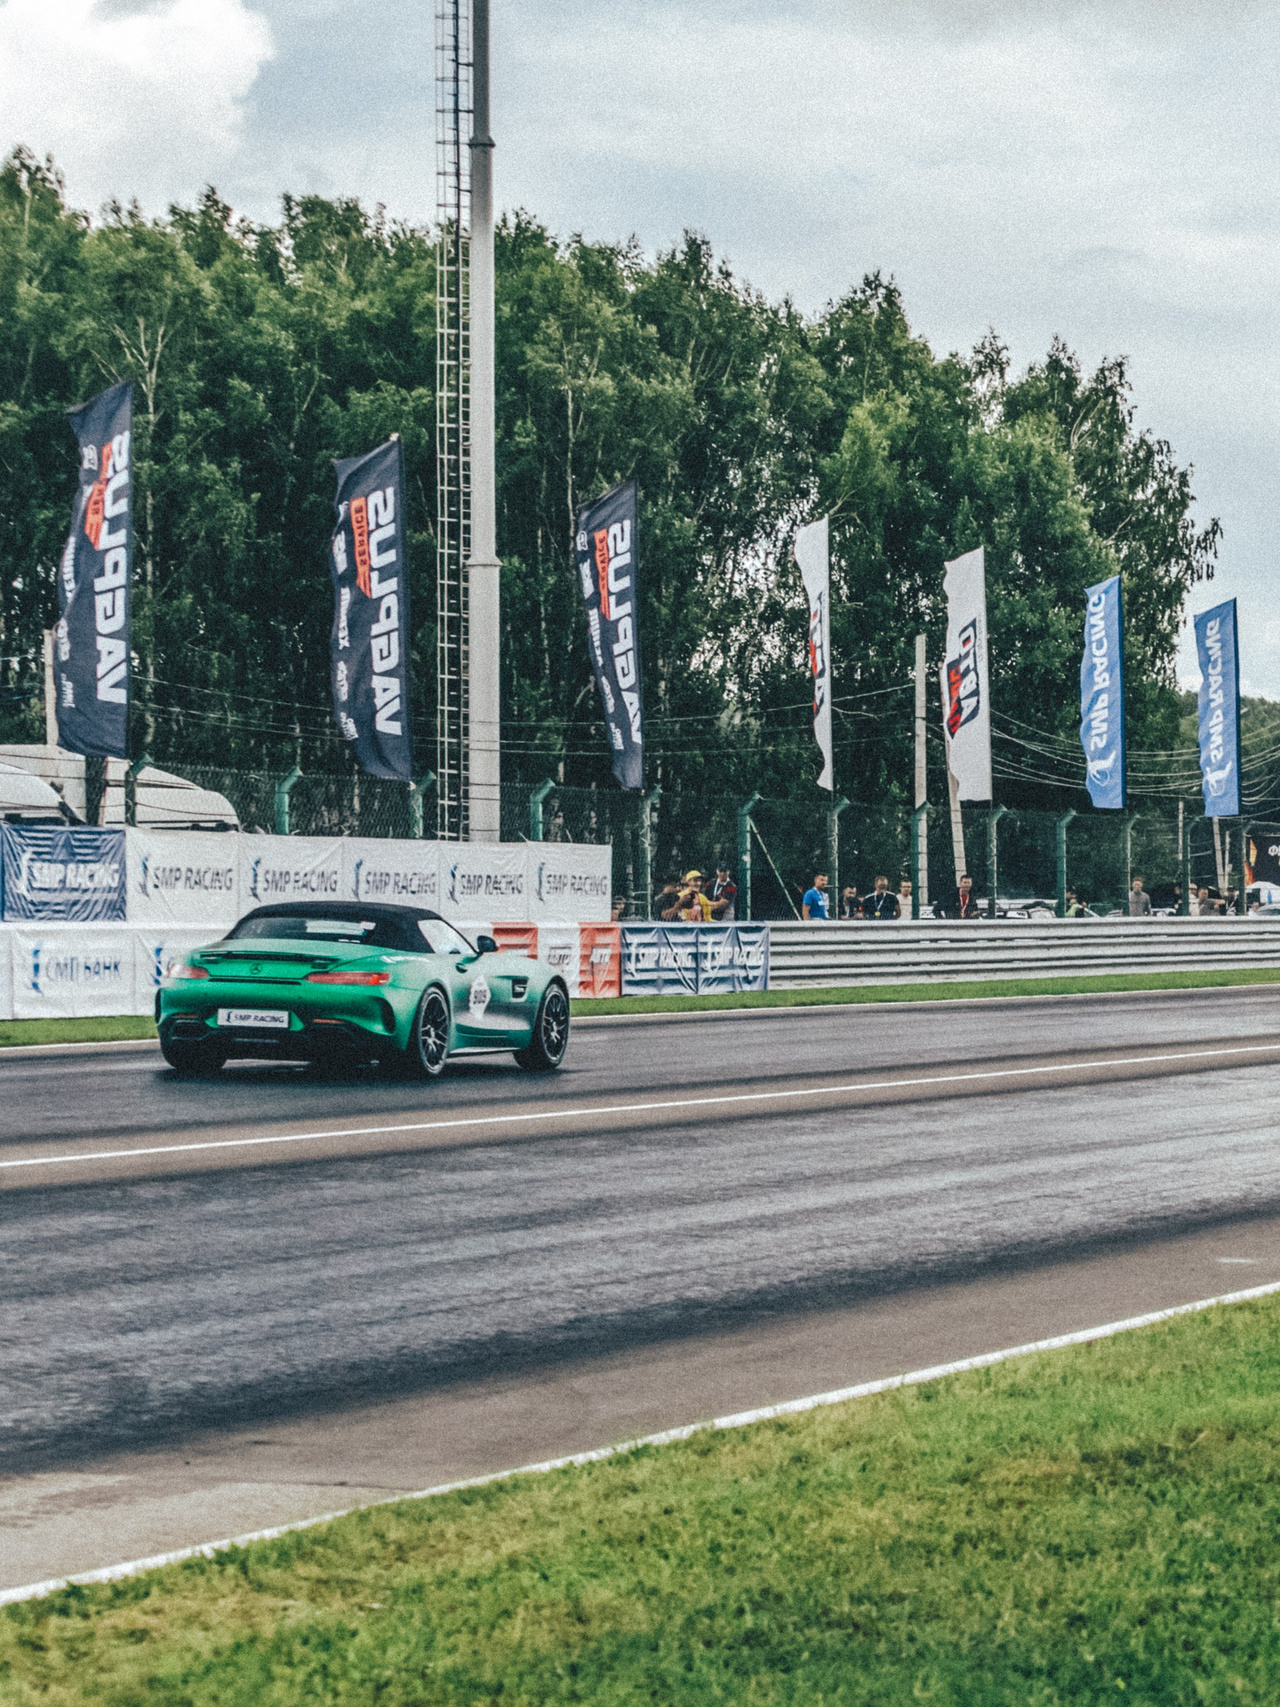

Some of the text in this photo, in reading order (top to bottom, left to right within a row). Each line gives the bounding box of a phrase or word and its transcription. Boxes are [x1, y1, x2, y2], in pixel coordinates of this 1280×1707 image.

[66, 863, 119, 888] RACING
[153, 867, 233, 890] SMP RACING
[263, 870, 338, 893] SMP RACING
[365, 872, 437, 895] SMP RACING
[460, 873, 482, 895] SMP
[546, 874, 568, 895] SMP
[253, 1015, 284, 1023] RACING
